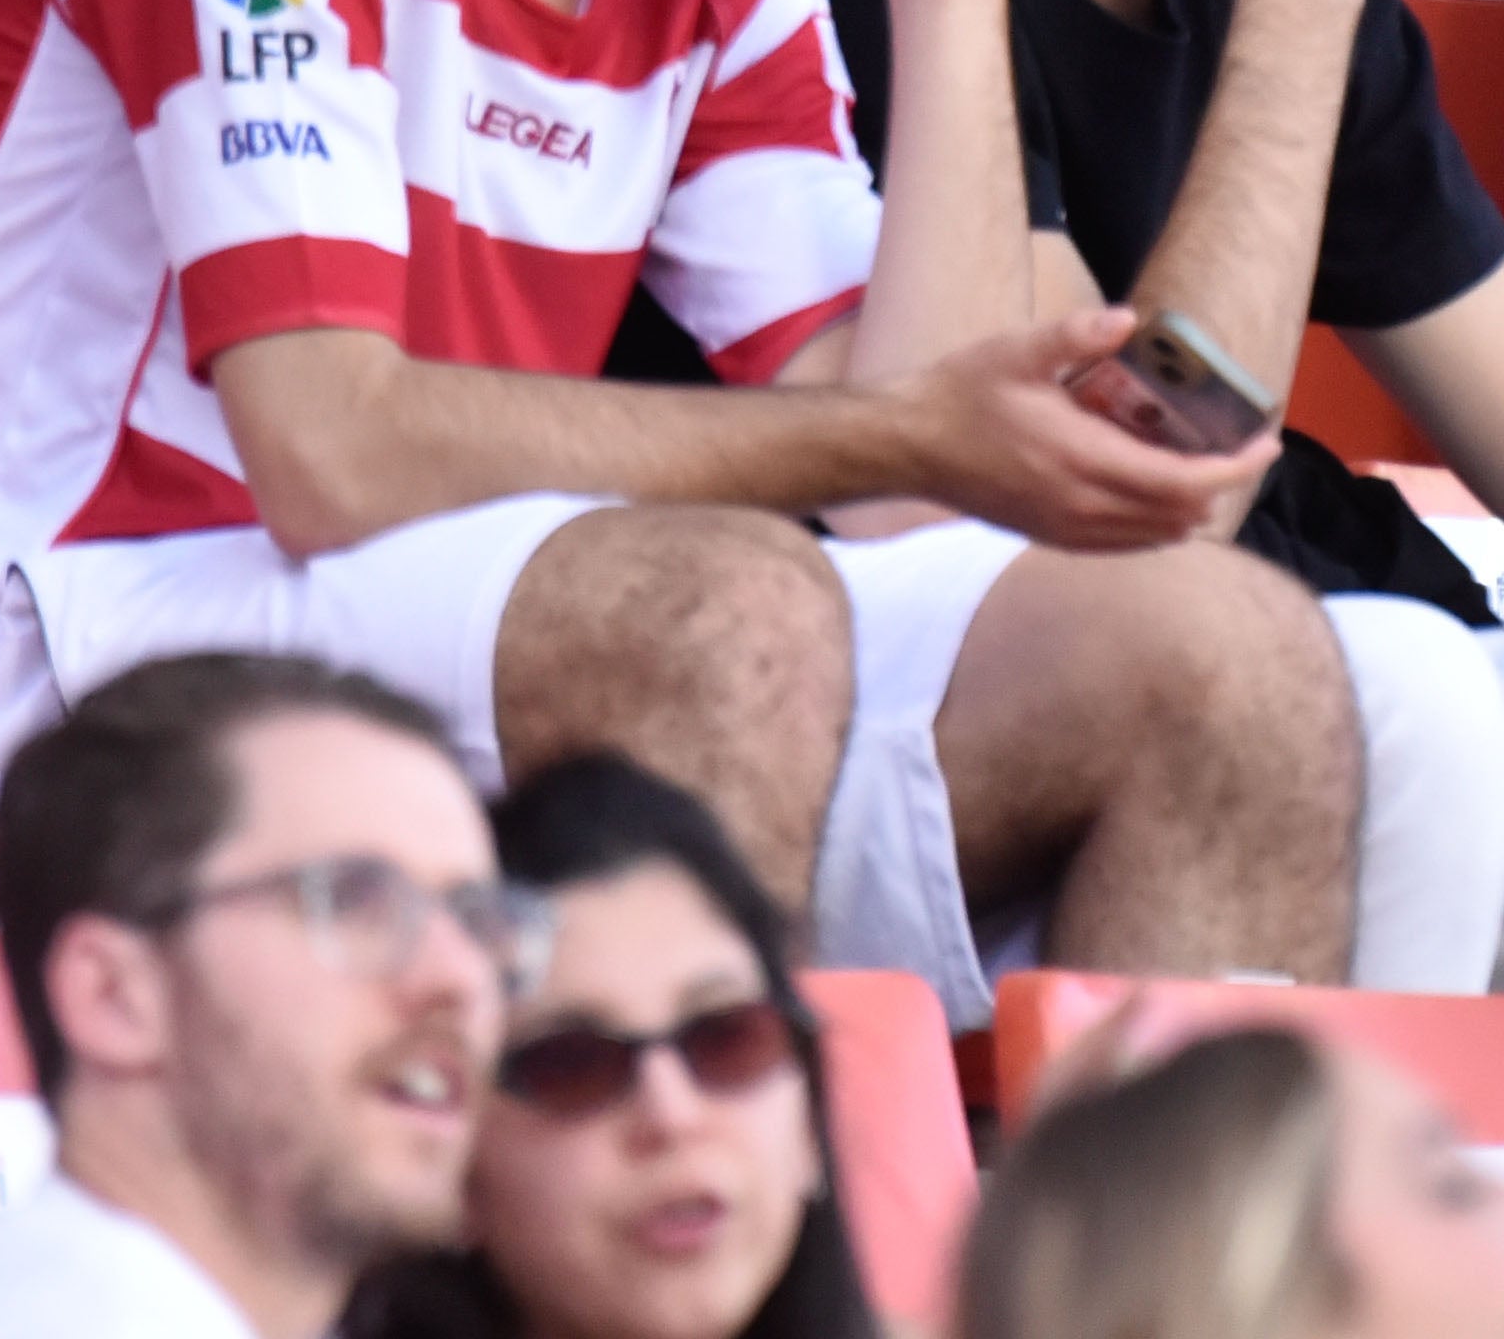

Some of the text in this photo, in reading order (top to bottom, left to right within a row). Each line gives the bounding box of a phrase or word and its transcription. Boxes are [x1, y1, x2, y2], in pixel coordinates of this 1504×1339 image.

[220, 29, 317, 84] LFP
[219, 121, 332, 166] BBVA
[464, 91, 593, 169] LEGEA
